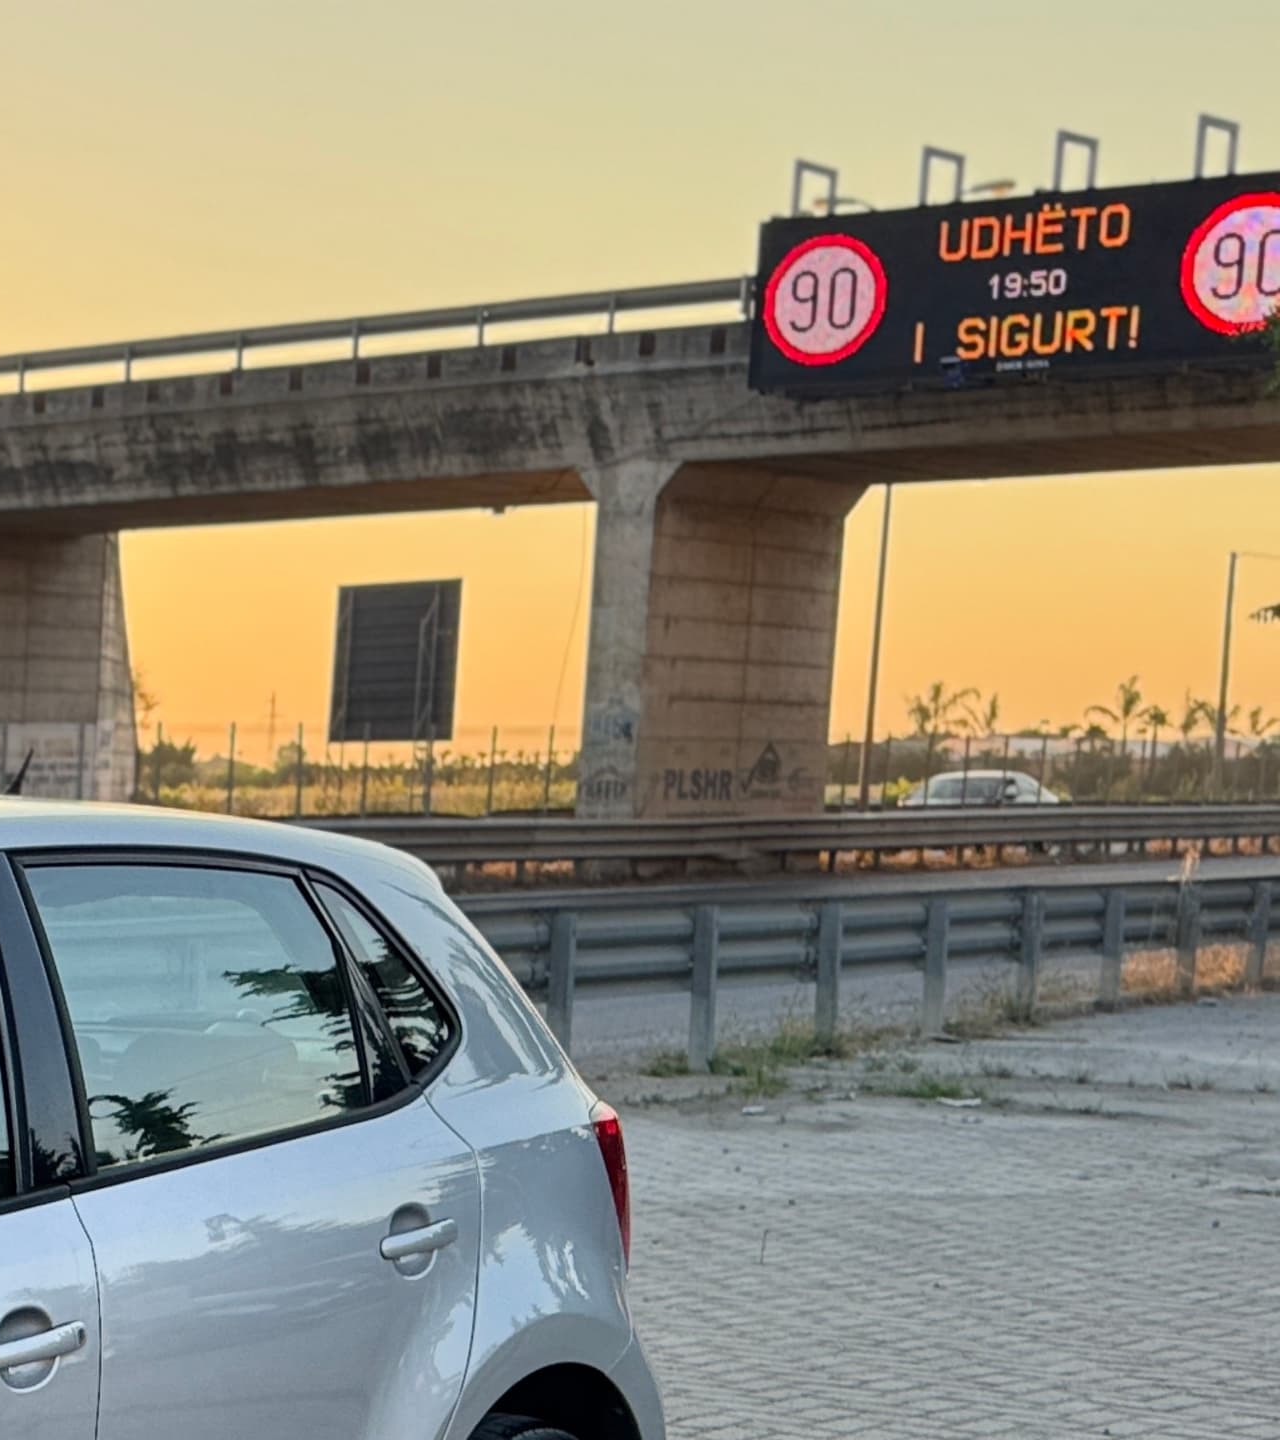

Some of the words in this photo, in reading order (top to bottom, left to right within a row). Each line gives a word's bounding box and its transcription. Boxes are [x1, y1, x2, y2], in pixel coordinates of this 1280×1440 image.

[940, 203, 1131, 262] UDHËTO
[789, 268, 858, 333] 90
[988, 269, 1068, 300] 19:50
[913, 322, 925, 364] I
[956, 305, 1139, 360] SIGURT!
